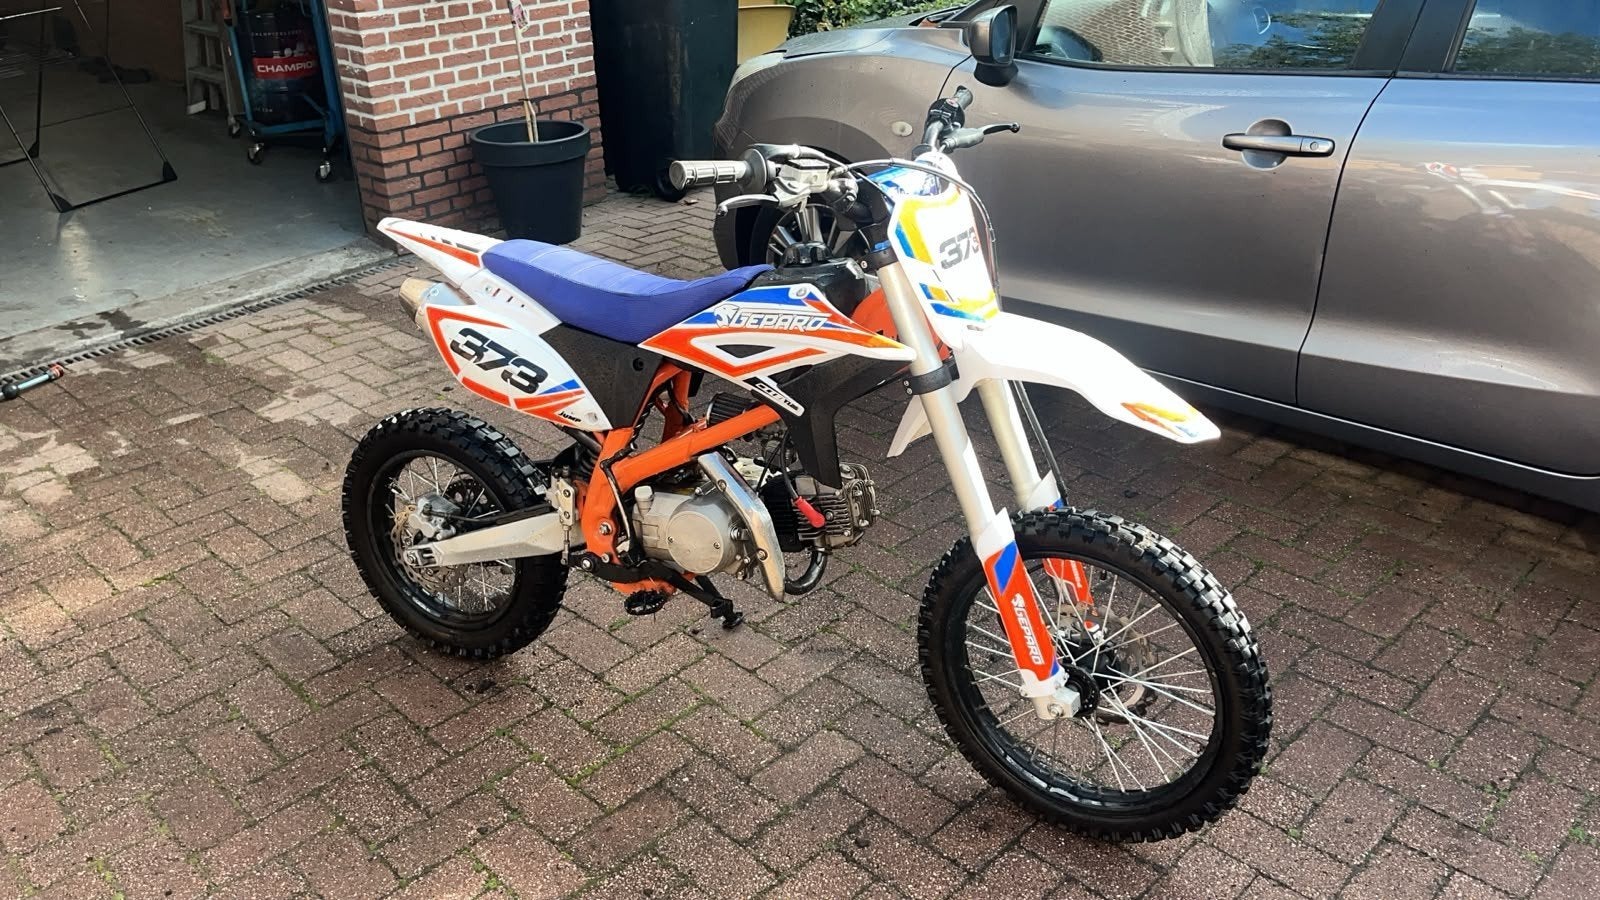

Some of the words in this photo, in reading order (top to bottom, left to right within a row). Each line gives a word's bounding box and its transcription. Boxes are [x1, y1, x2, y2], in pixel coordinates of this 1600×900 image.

[939, 226, 979, 269] 373
[731, 308, 832, 333] GEPARD
[450, 327, 549, 394] 373
[1014, 607, 1045, 665] GEPARD
